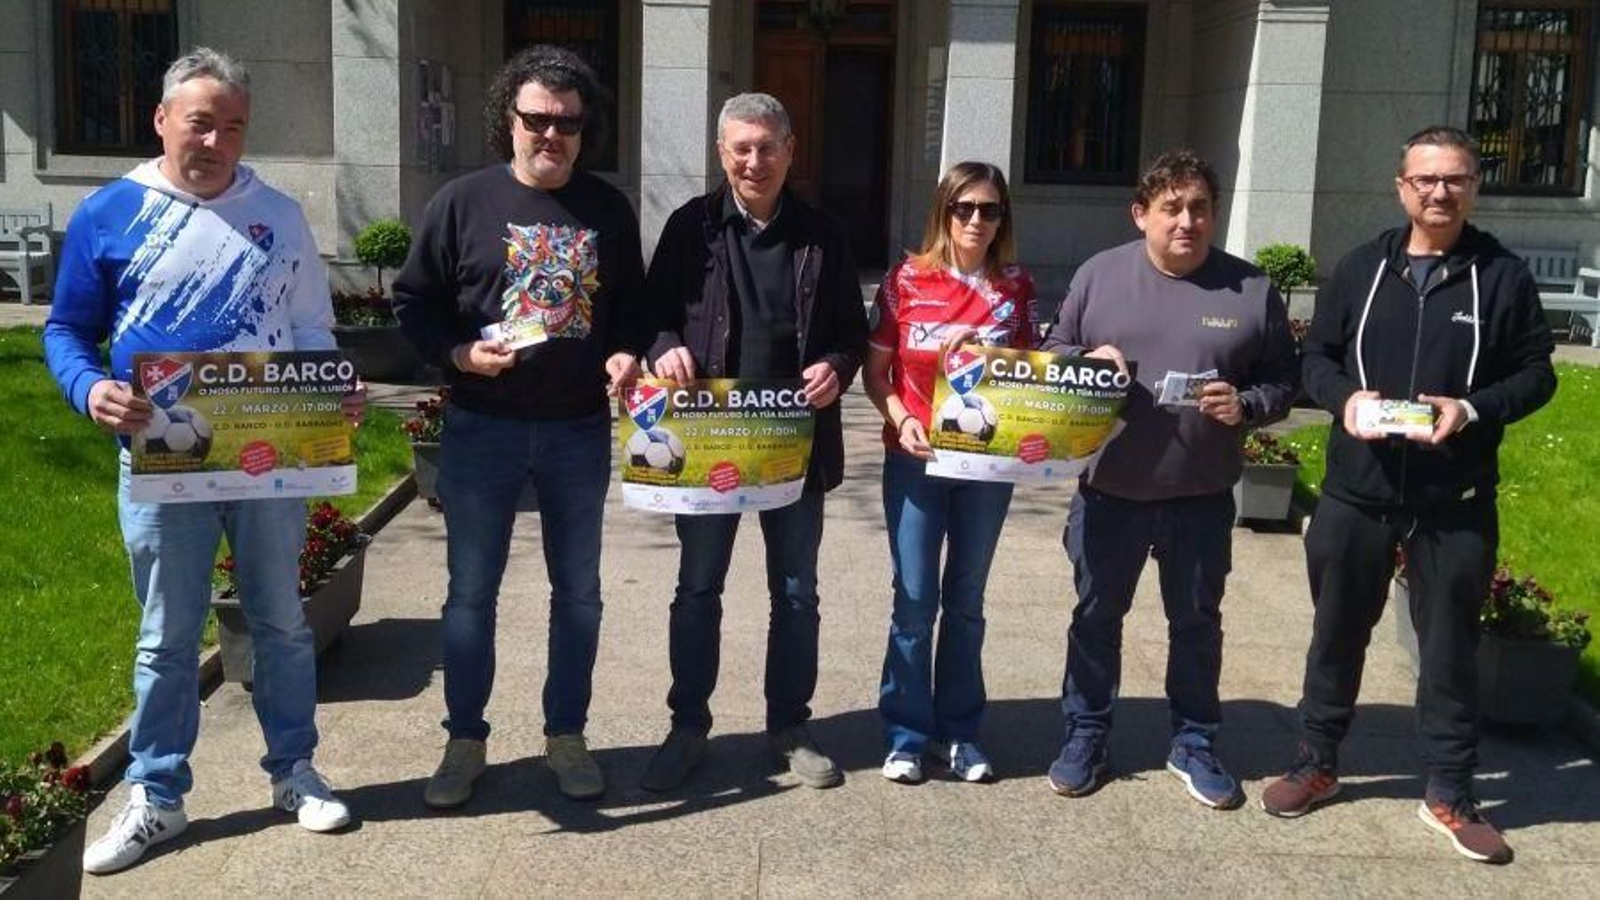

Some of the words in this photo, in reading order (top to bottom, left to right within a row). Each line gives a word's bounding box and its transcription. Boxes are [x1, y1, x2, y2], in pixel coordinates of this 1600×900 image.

[199, 364, 254, 383] C.D.
[264, 360, 354, 382] BARCO
[990, 359, 1037, 380] C.D.
[1045, 364, 1130, 389] BARCO
[208, 387, 239, 395] NOSO
[672, 390, 720, 408] C.D.
[728, 389, 811, 408] BARCO
[242, 403, 288, 414] MARZO
[1025, 400, 1065, 411] MARZO
[710, 427, 750, 436] MARZO
